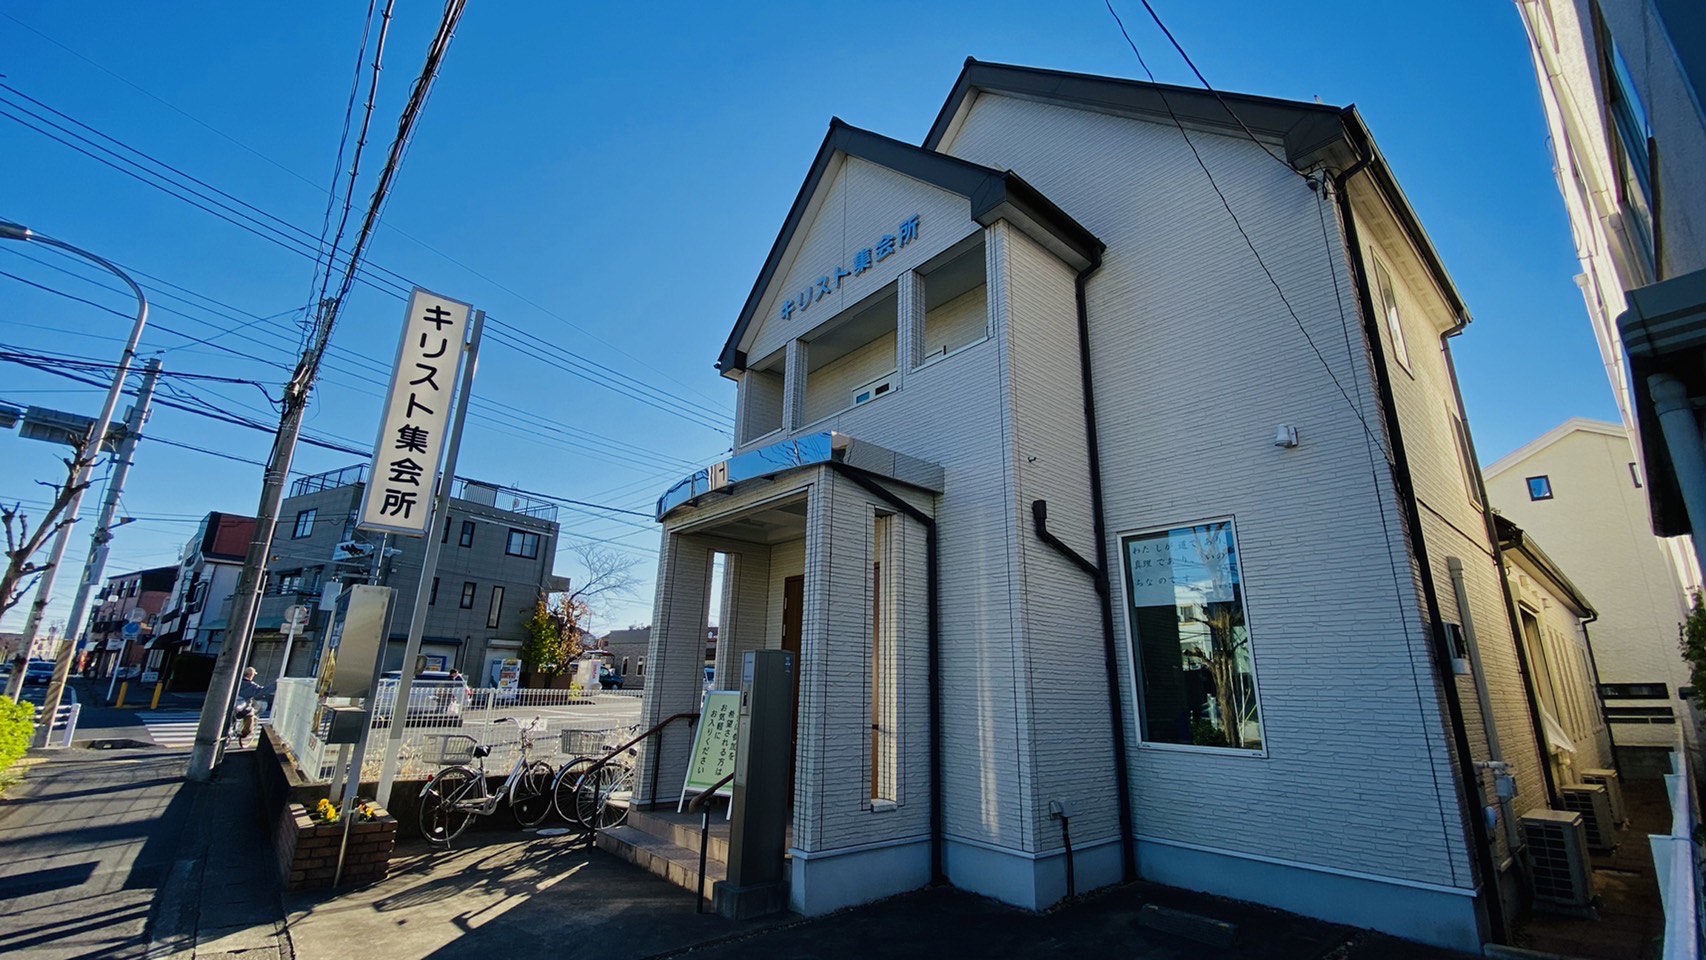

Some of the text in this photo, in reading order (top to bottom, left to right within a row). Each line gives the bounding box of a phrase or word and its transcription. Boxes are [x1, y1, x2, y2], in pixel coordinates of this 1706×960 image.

[780, 213, 922, 321] キリスト集会所
[380, 305, 454, 519] キリスト集会所
[697, 709, 718, 774] お入りください
[714, 704, 728, 740] お気軽に
[715, 710, 735, 776] 希望される方は
